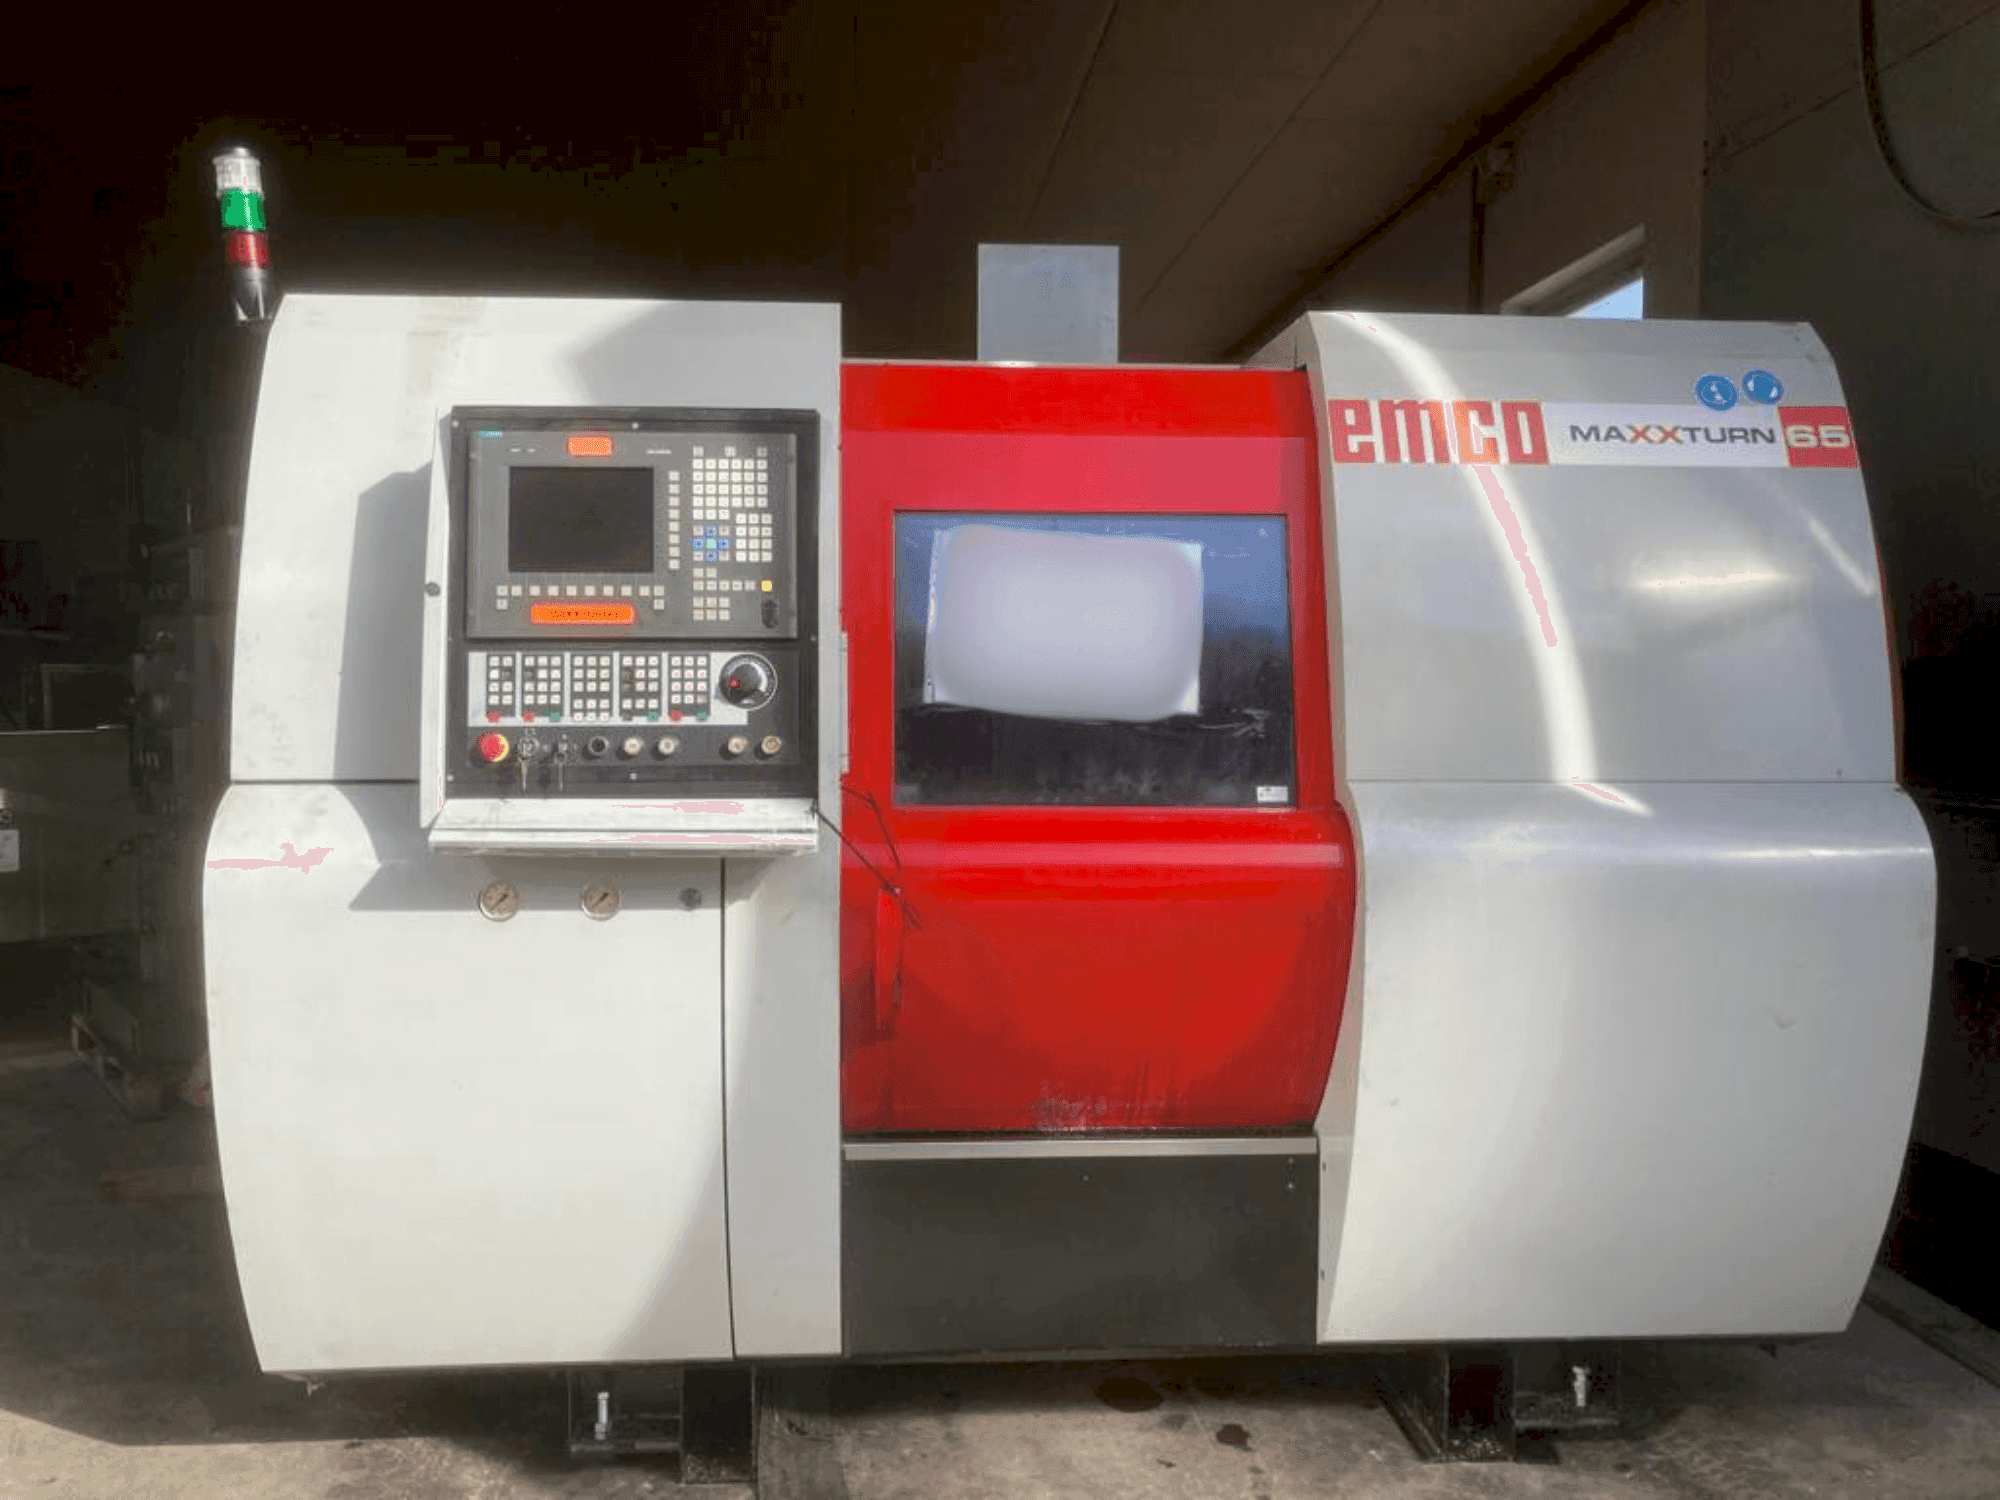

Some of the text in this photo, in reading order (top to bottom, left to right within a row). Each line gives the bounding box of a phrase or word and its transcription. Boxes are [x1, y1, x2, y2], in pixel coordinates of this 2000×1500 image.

[1328, 400, 1852, 464] emco MAXXTURN 65
